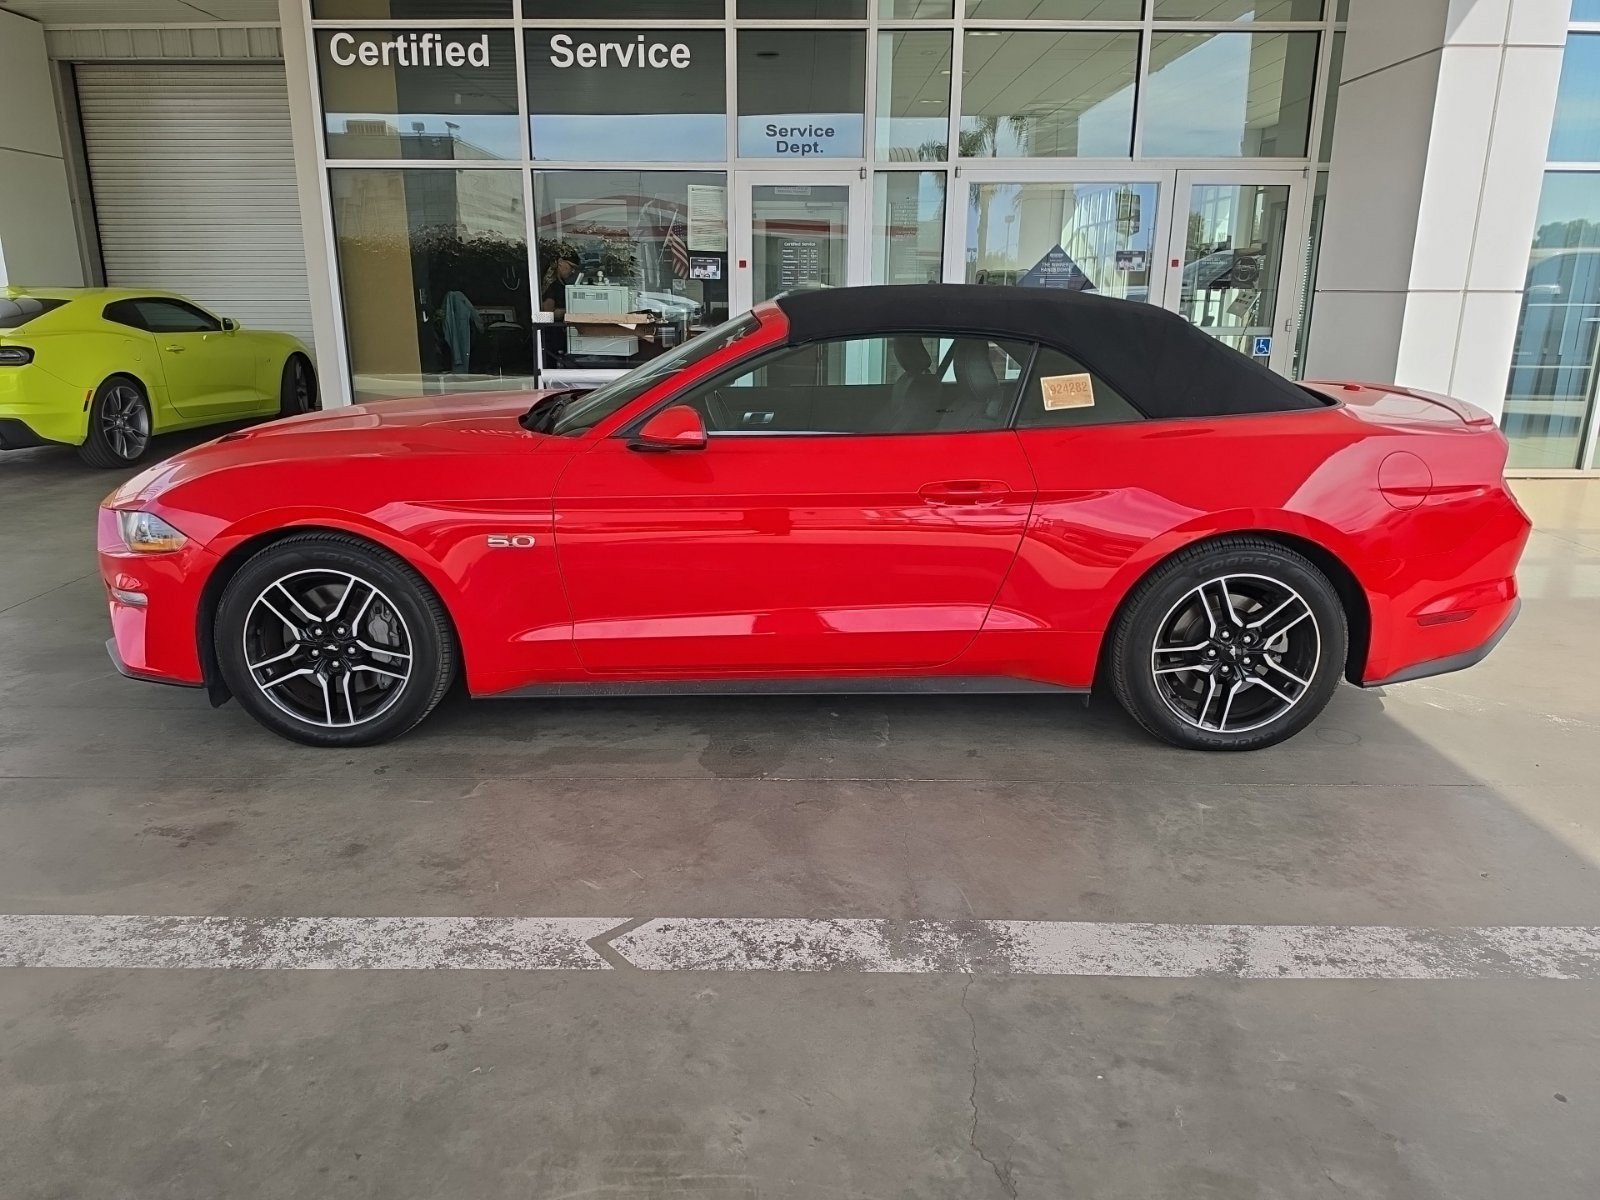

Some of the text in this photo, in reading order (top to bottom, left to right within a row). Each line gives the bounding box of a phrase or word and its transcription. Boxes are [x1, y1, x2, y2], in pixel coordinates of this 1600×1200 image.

[329, 32, 691, 69] Certified Service
[765, 124, 835, 138] Service
[776, 140, 824, 157] Dept.
[1049, 381, 1088, 395] 924282
[487, 534, 536, 548] 5.0
[1198, 556, 1281, 576] COOPER
